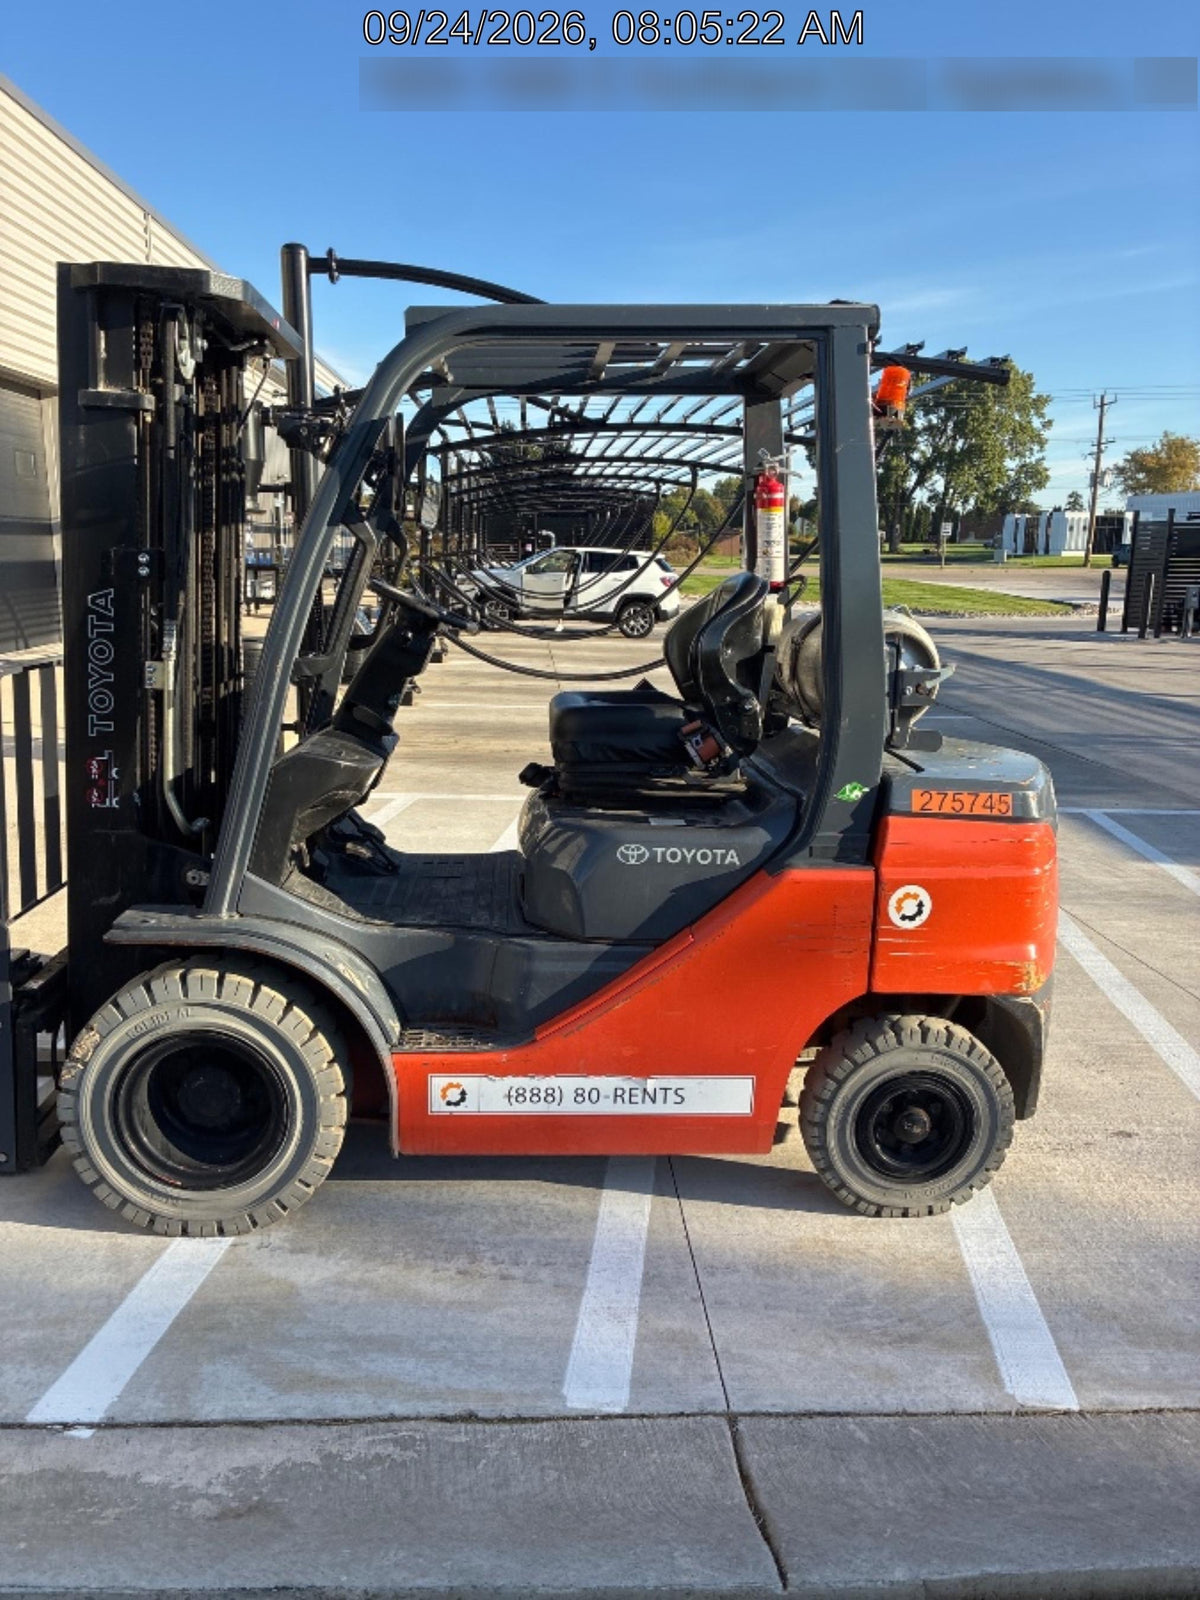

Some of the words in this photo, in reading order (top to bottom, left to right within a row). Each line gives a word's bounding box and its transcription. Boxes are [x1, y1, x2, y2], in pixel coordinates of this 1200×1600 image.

[87, 587, 115, 737] TOYOTA
[919, 790, 1010, 815] 275745
[652, 847, 740, 865] TOYOTA
[507, 1085, 563, 1107] (888)
[573, 1086, 686, 1105] 80-RENTS
